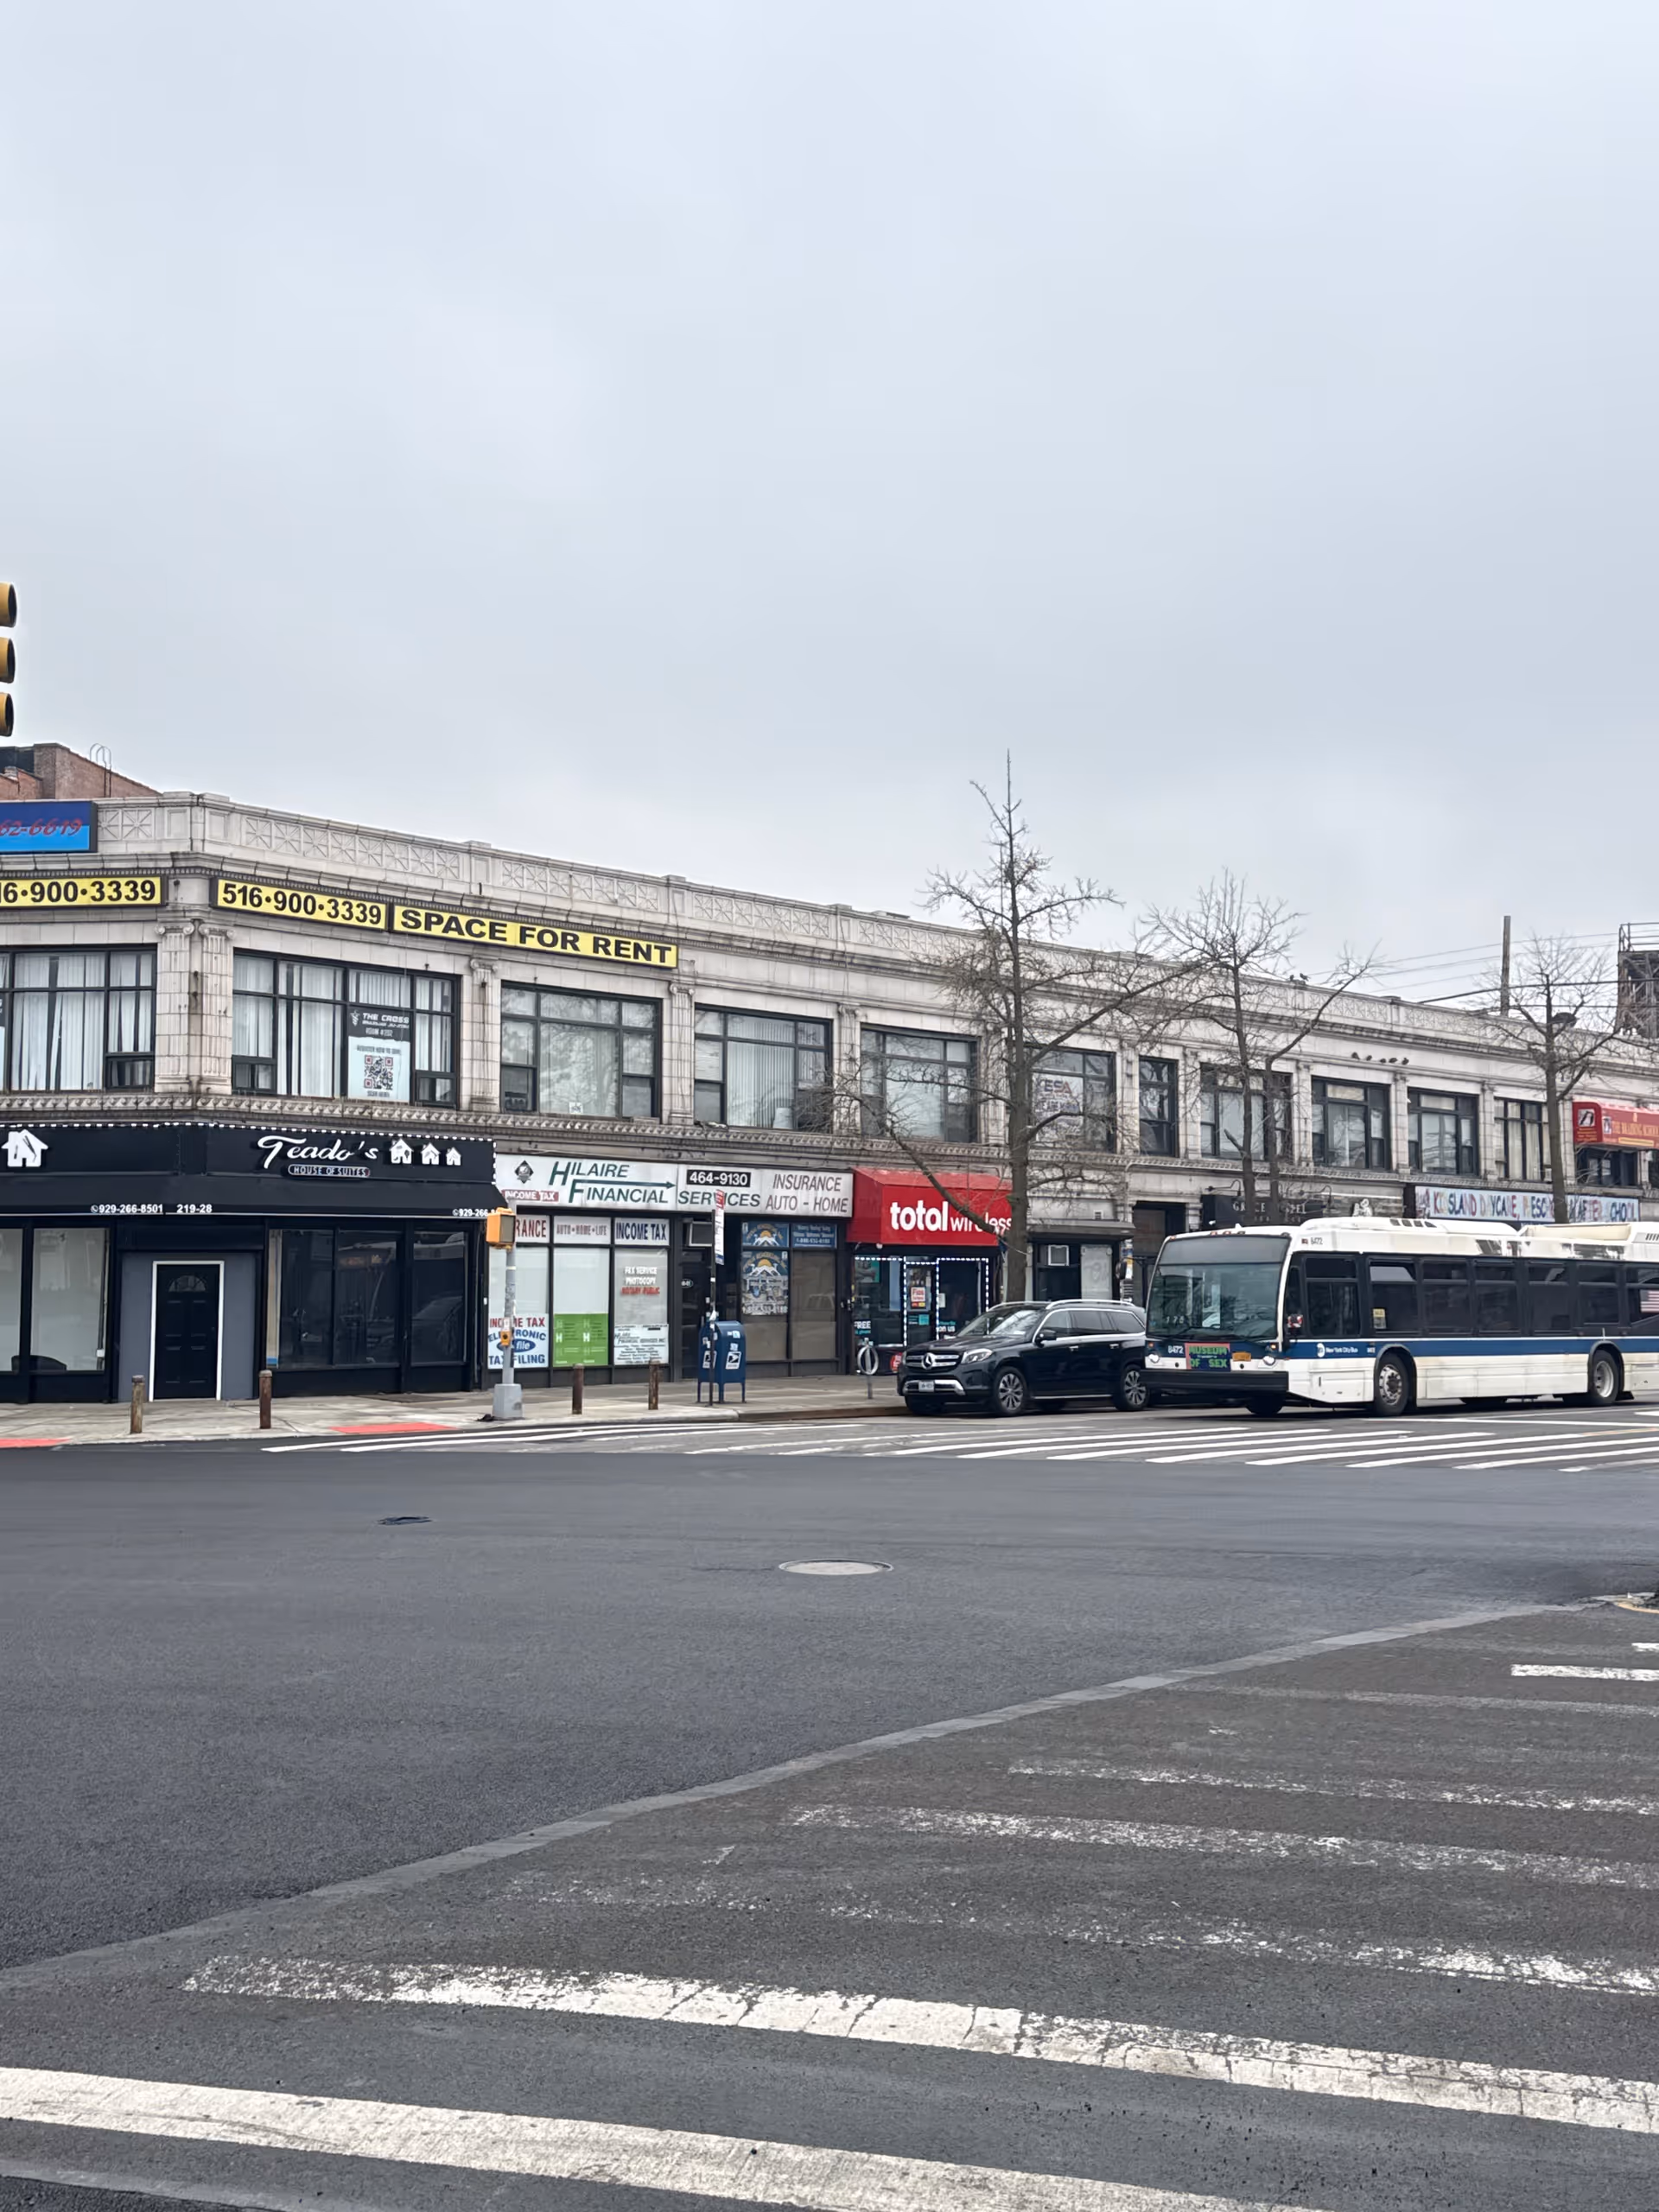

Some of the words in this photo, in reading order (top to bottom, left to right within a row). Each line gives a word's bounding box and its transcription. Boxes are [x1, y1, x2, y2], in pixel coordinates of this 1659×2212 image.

[401, 909, 508, 942] SPACE
[519, 925, 581, 952] FOR
[593, 936, 671, 963] RENT
[362, 1013, 379, 1021] THE
[257, 1135, 378, 1169] Teado's
[294, 1166, 321, 1175] HOUSE
[549, 1160, 630, 1186] HILAIRE
[690, 1172, 748, 1186] 464-9130
[772, 1173, 842, 1192] INSURANCE
[538, 1192, 555, 1201] TAX
[569, 1179, 669, 1204] FINANCIAL
[678, 1191, 760, 1208] SERICES
[97, 1204, 163, 1213] 929-266-8501
[176, 1204, 213, 1214] 219-28
[766, 1194, 798, 1211] AUTO
[813, 1197, 849, 1213] HOME
[890, 1200, 948, 1231] total
[616, 1223, 648, 1240] INCOME
[651, 1224, 667, 1240] TAX
[526, 1317, 545, 1328] TAX
[1188, 1345, 1228, 1355] MUSEUM
[1190, 1358, 1200, 1368] OF
[1208, 1358, 1227, 1368] SEX
